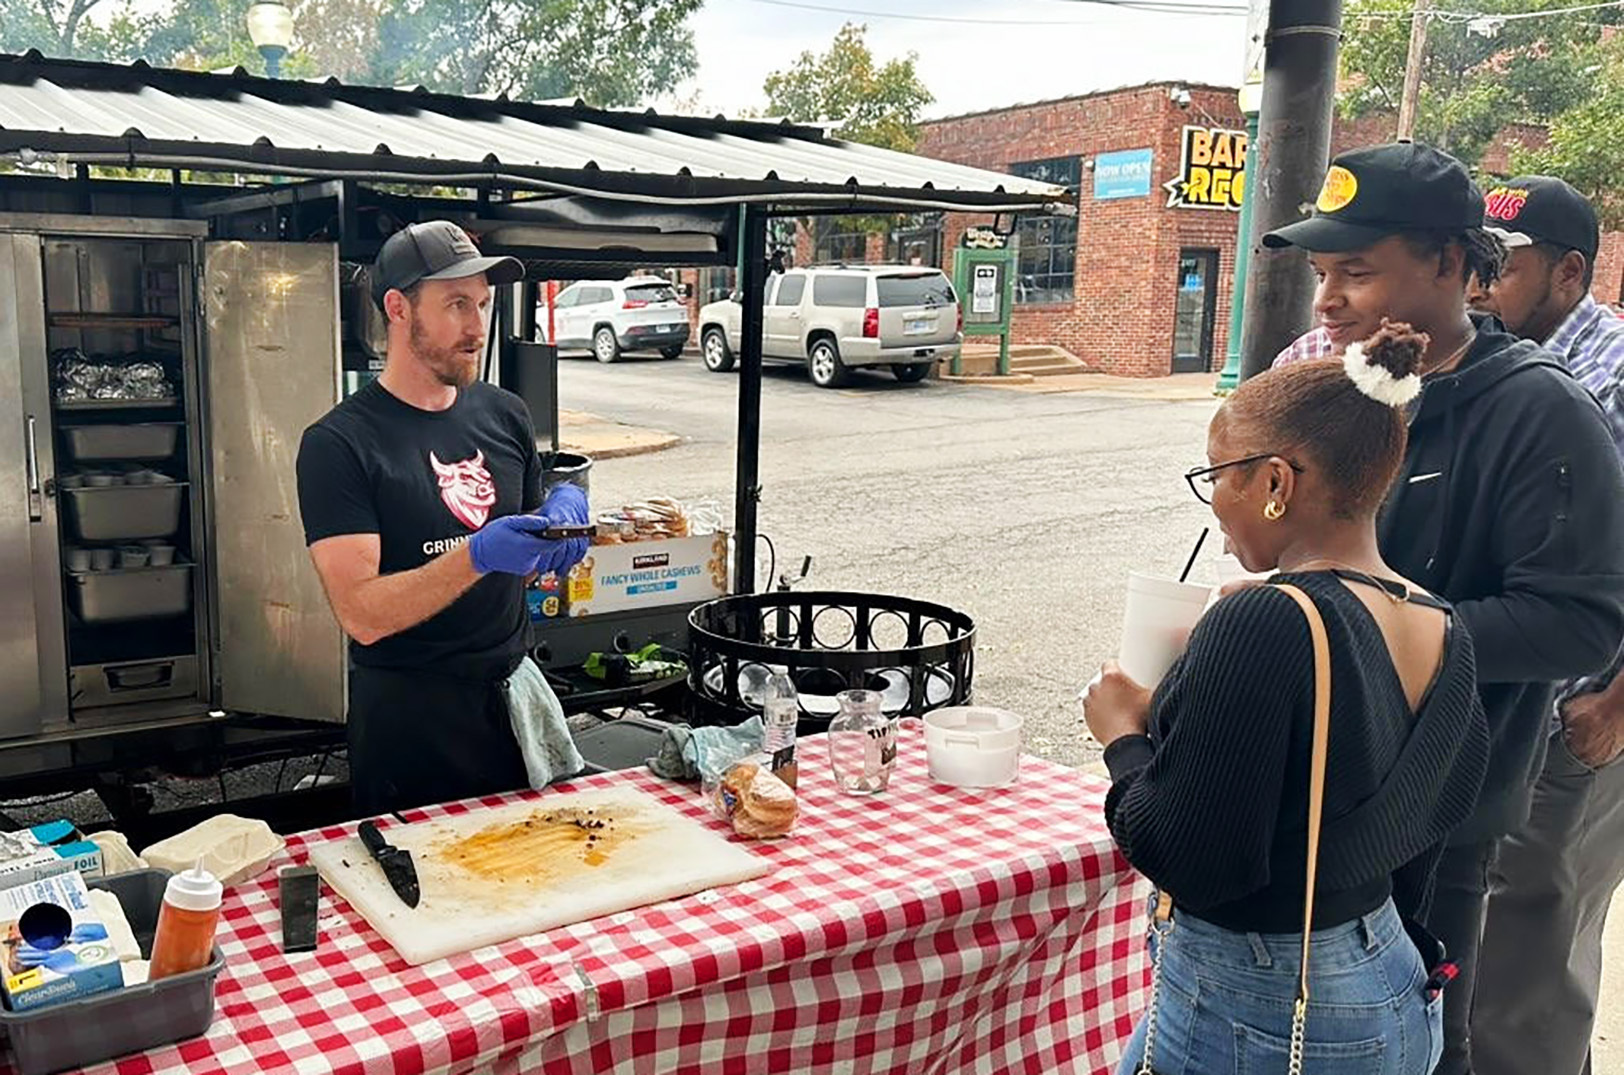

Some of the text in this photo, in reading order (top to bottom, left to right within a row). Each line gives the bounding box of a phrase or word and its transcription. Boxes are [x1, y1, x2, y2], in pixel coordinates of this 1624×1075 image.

[635, 554, 668, 564] KIRKLAND
[601, 564, 702, 587] FANCY WHOLE CASHEWS
